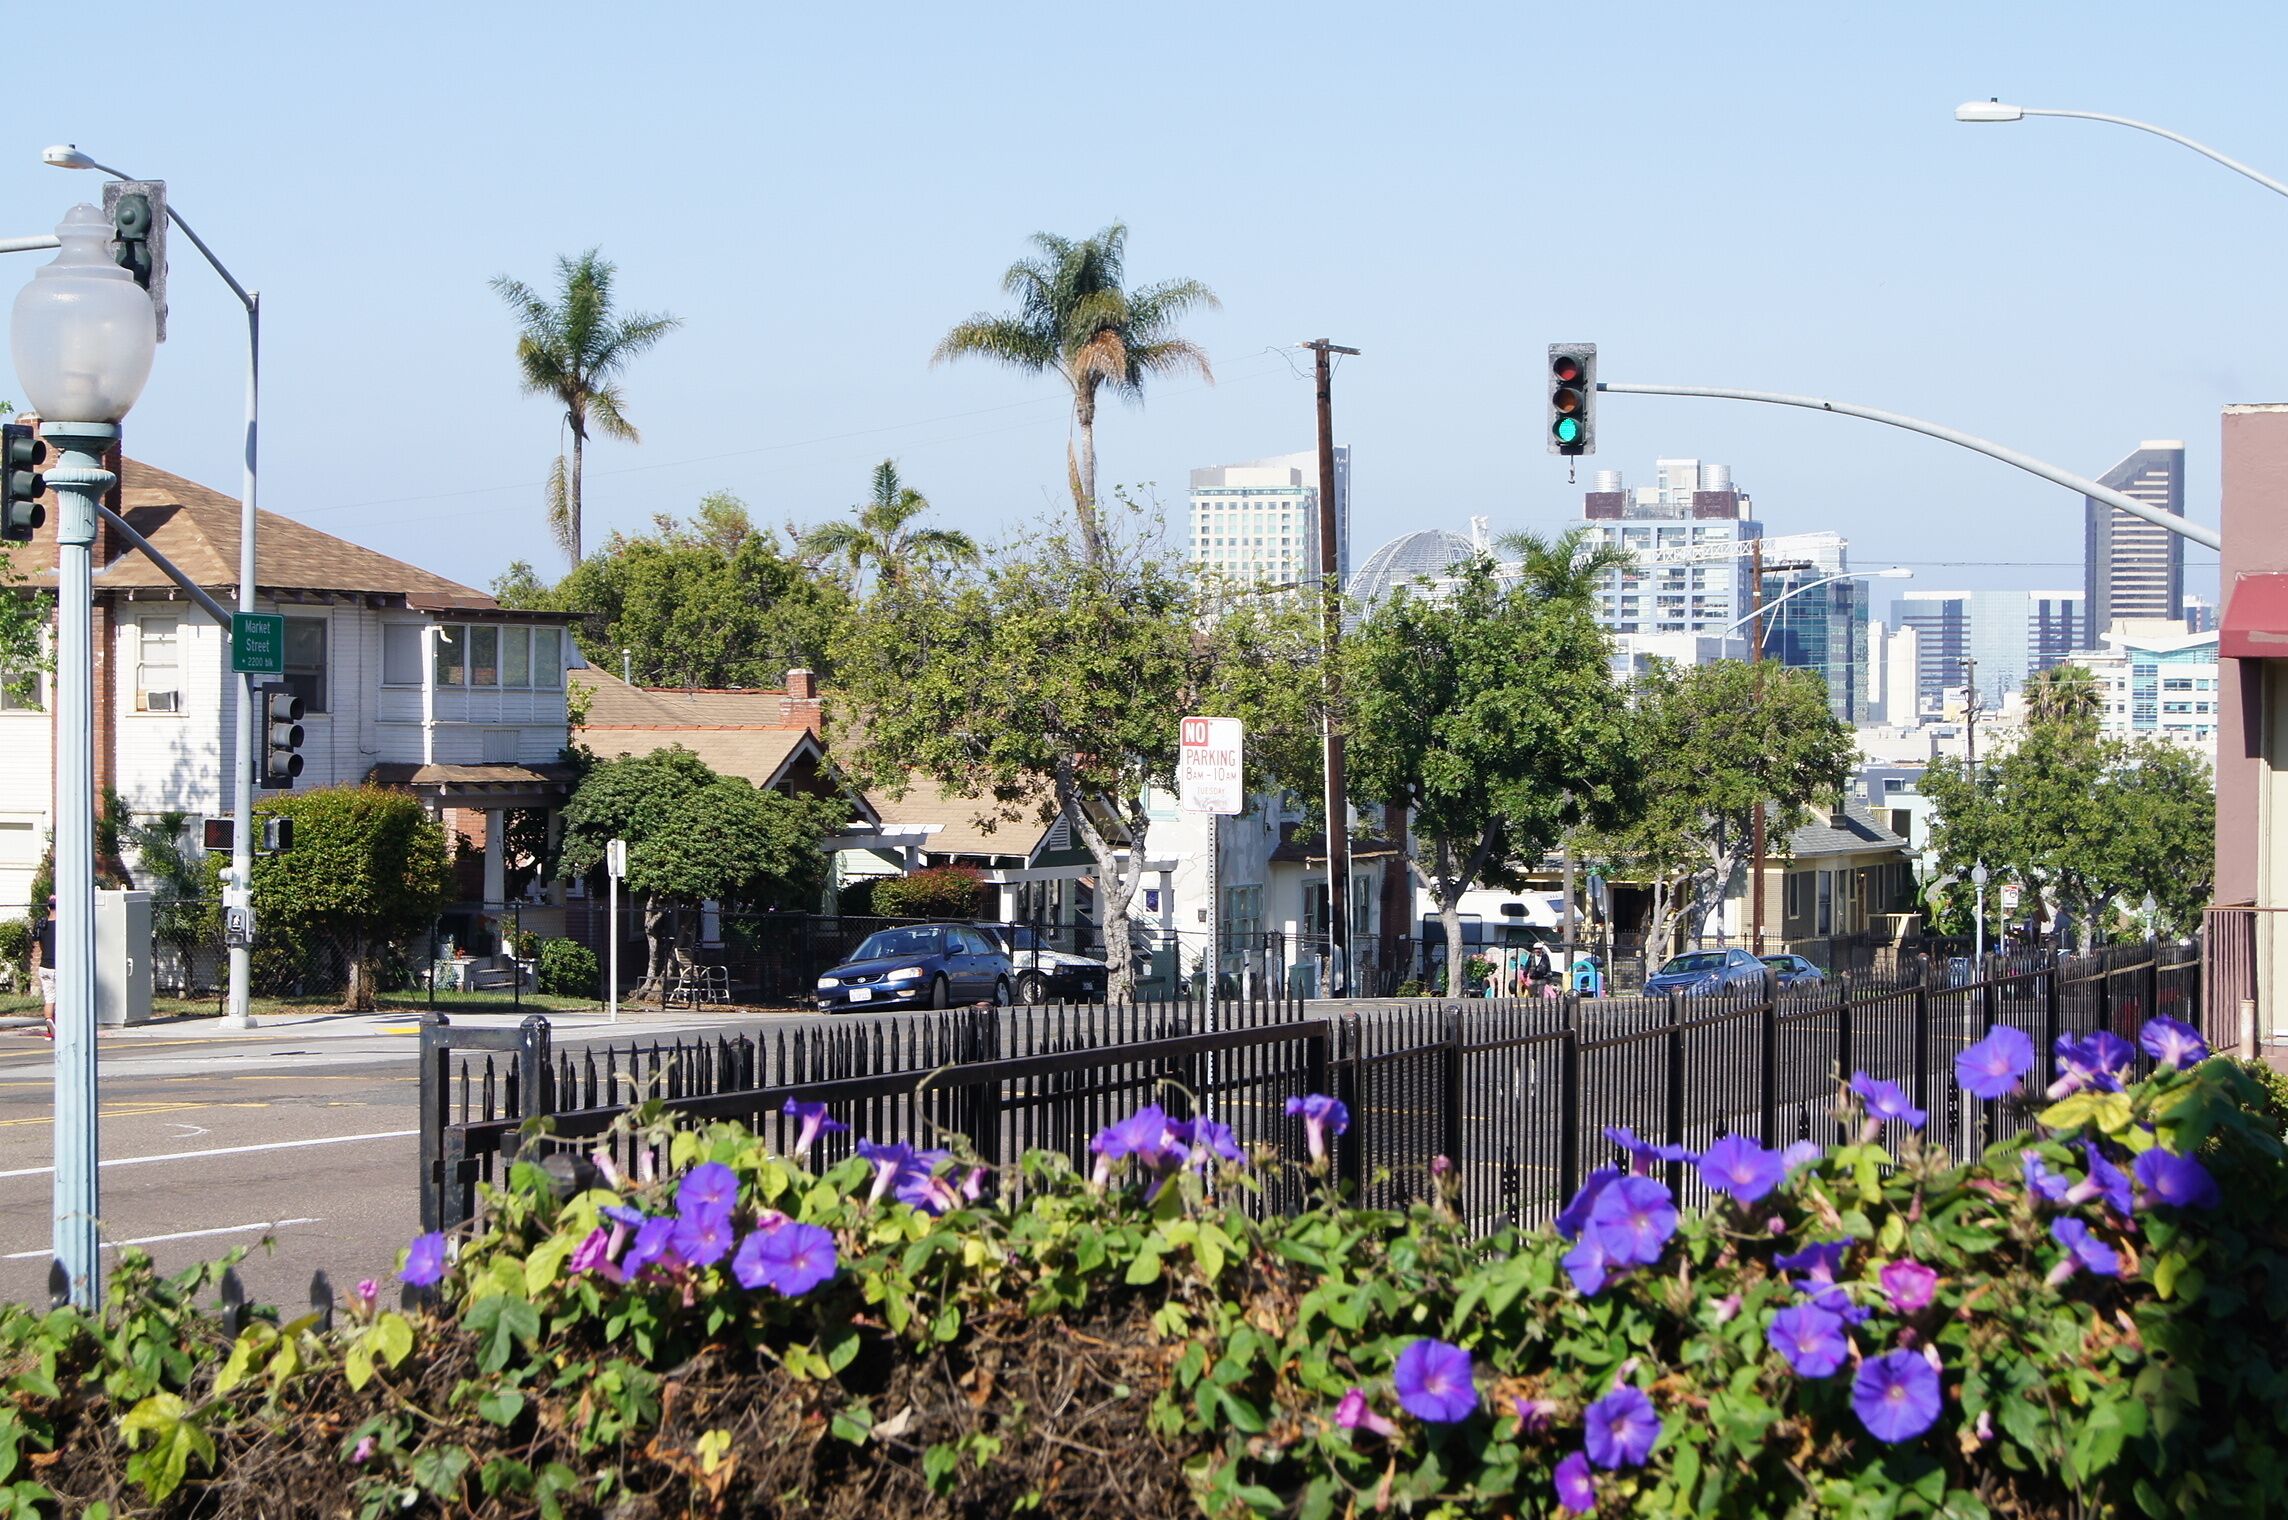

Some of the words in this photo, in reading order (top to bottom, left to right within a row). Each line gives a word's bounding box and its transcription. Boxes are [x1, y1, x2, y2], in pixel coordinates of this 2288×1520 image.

[245, 619, 271, 634] Market
[246, 638, 270, 652] Street
[248, 657, 263, 667] 2200
[1185, 722, 1206, 743] NO
[1186, 749, 1236, 767] PARKING
[1197, 786, 1225, 795] TUESDAY
